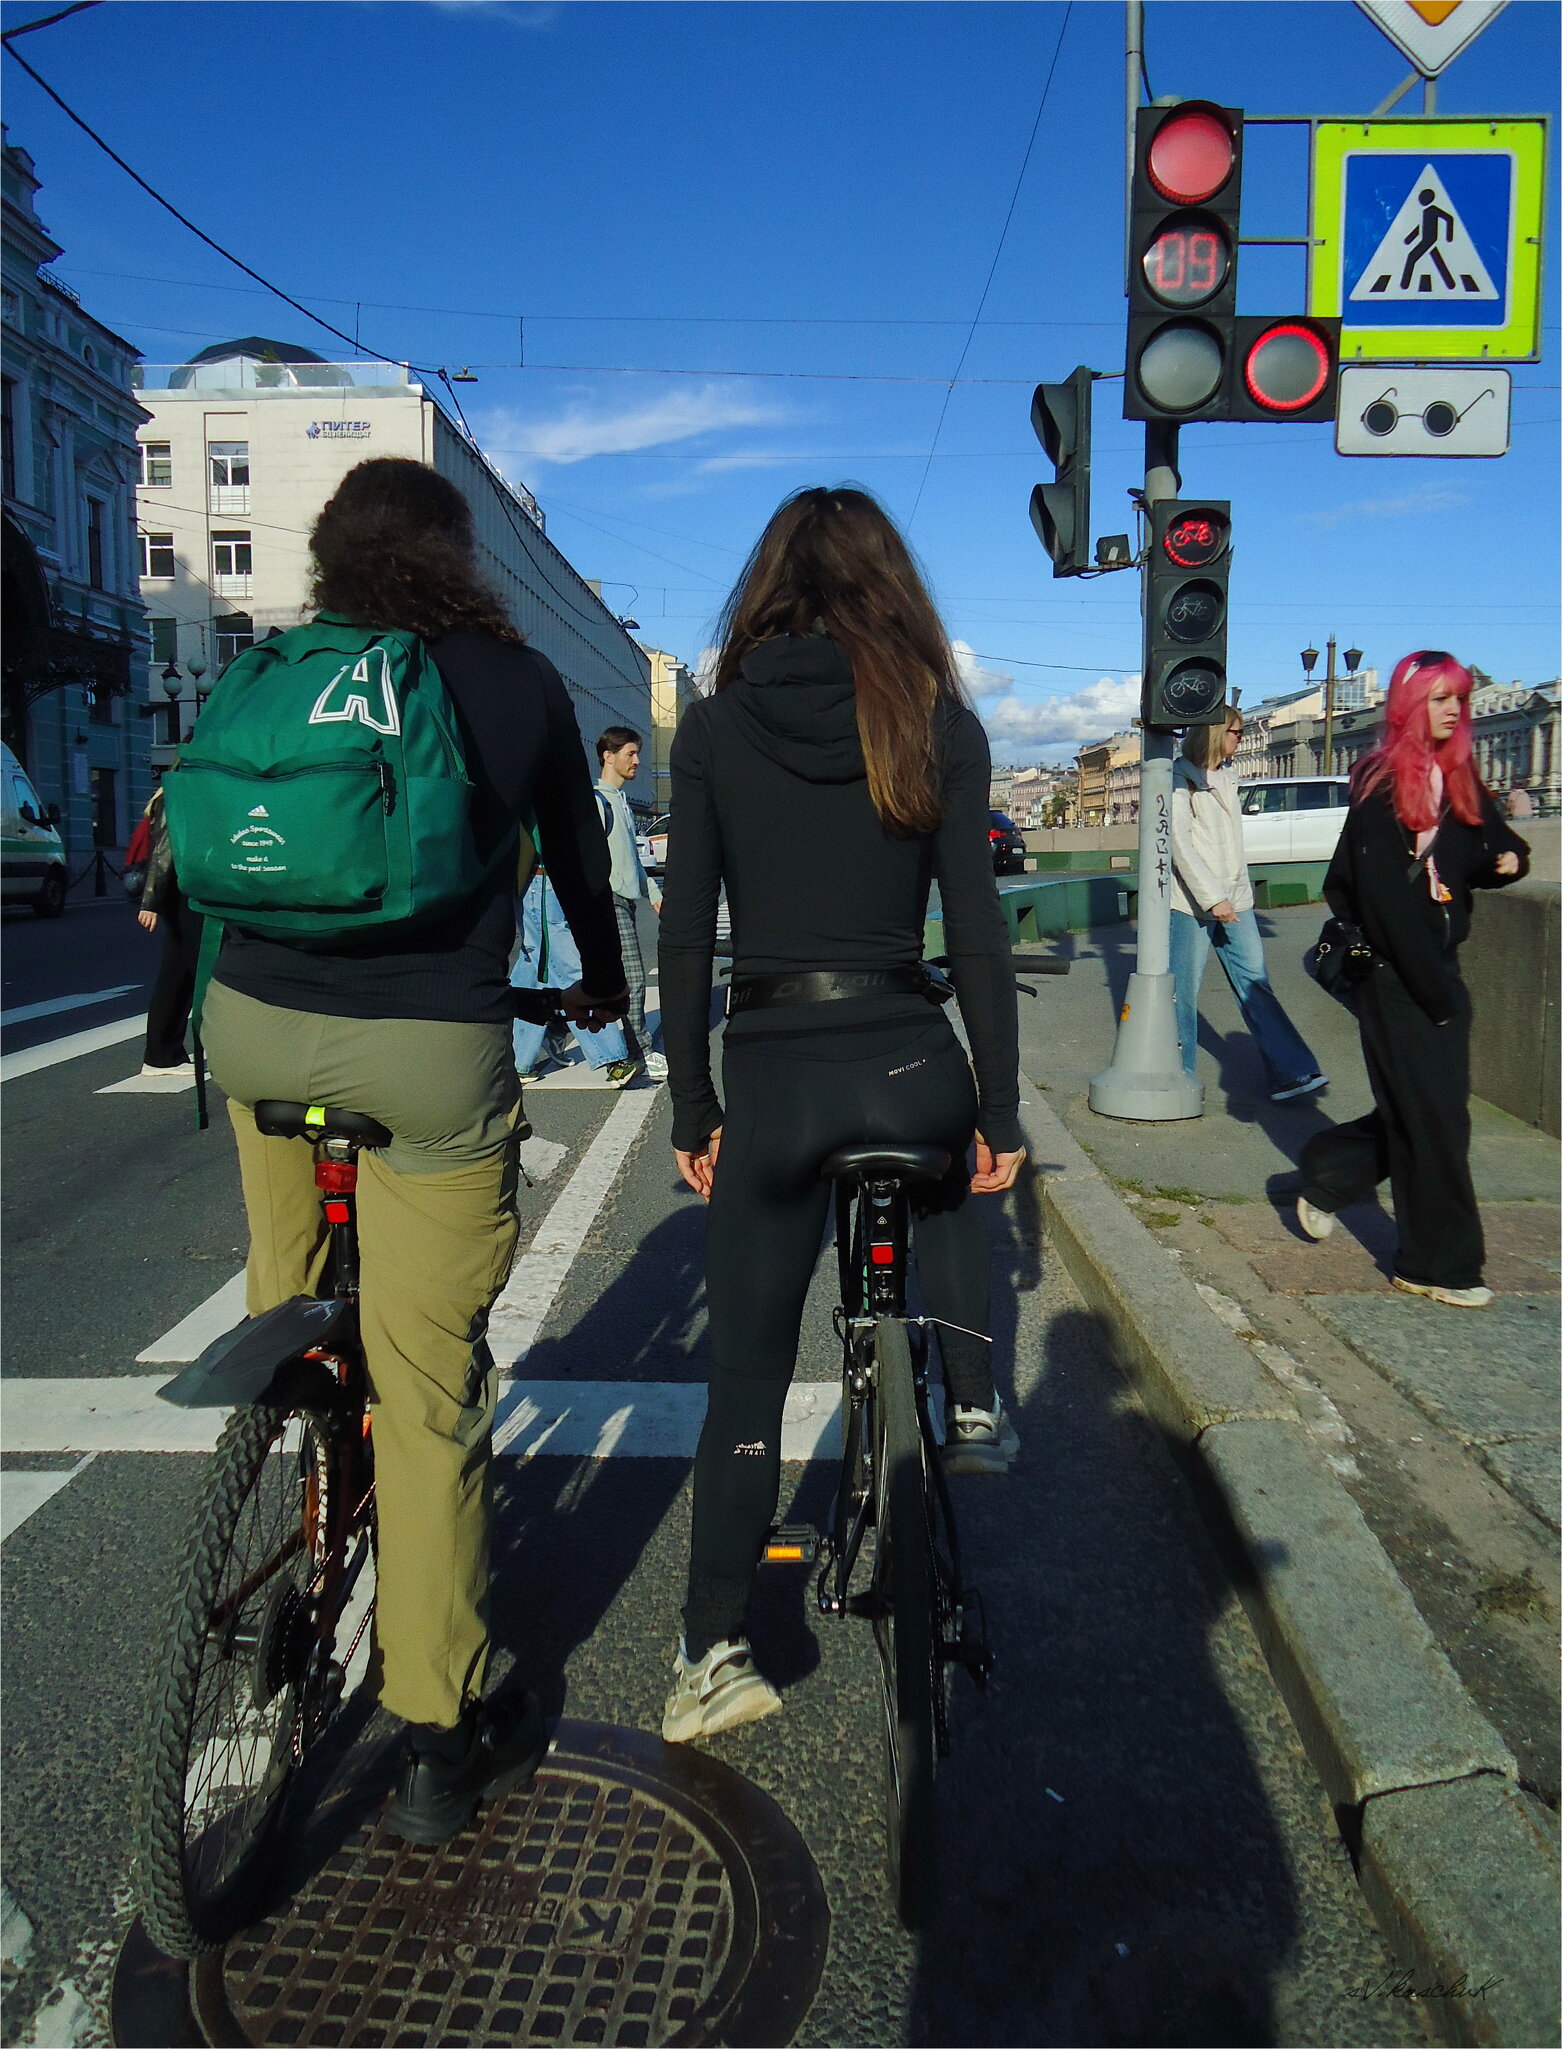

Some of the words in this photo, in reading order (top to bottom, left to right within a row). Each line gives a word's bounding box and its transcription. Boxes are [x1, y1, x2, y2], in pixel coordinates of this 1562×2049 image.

[1156, 233, 1218, 288] 09
[320, 421, 371, 431] ПИТЕР
[308, 645, 401, 736] A
[888, 1066, 905, 1077] MOVI
